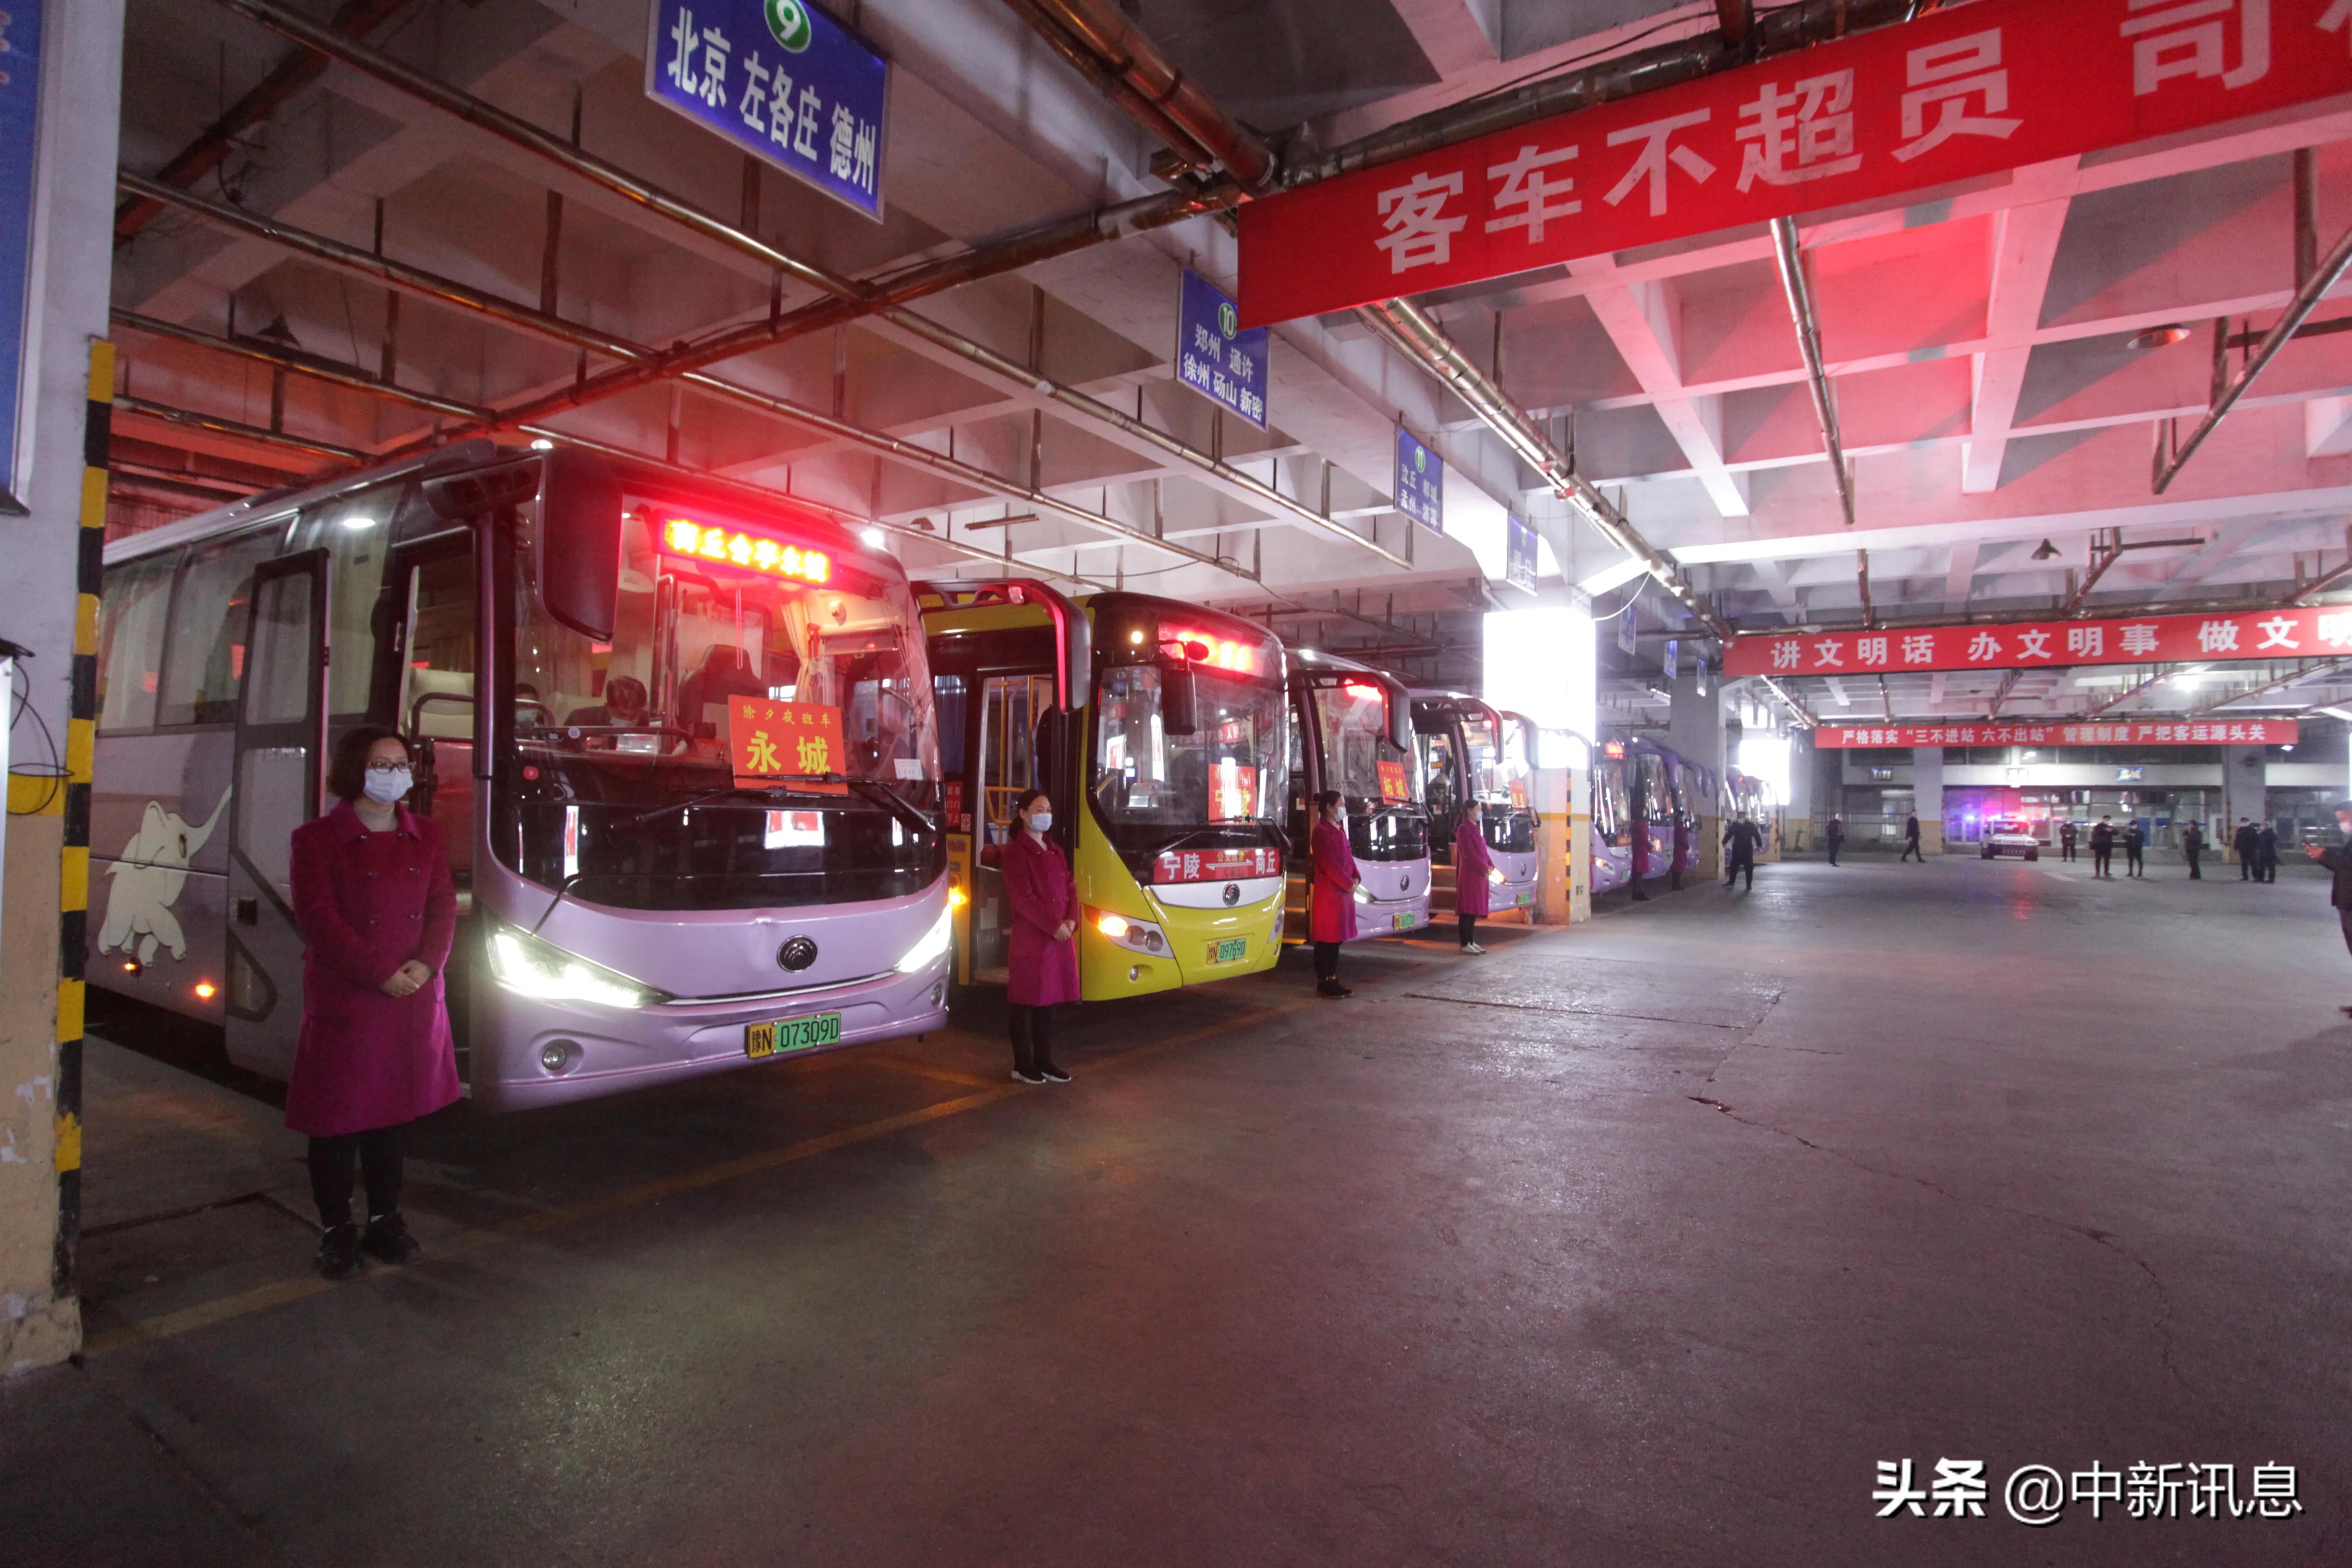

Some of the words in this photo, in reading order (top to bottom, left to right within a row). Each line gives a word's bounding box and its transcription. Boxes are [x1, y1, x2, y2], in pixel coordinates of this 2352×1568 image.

[776, 0, 802, 41] 9
[667, 6, 732, 108] 北京
[740, 50, 821, 162] 左各庄
[829, 102, 877, 196] 德州
[1374, 26, 2024, 276] 客车不超员
[2119, 0, 2352, 96] 司
[1223, 306, 1234, 336] 10
[1195, 323, 1221, 363] 郑州
[1229, 347, 1253, 383] 通许
[1184, 352, 1210, 390] 徐州
[1213, 371, 1237, 406] 砀山
[1240, 387, 1264, 422] 新密
[1770, 634, 1935, 669] 讲文明话
[1968, 624, 2159, 661] 办文明事
[743, 705, 831, 729] 除夕夜班车
[2138, 723, 2266, 742] 严把客运源头关
[746, 730, 831, 775] 永城
[1163, 852, 1200, 880] 宁陵
[1255, 850, 1276, 875] 商丘
